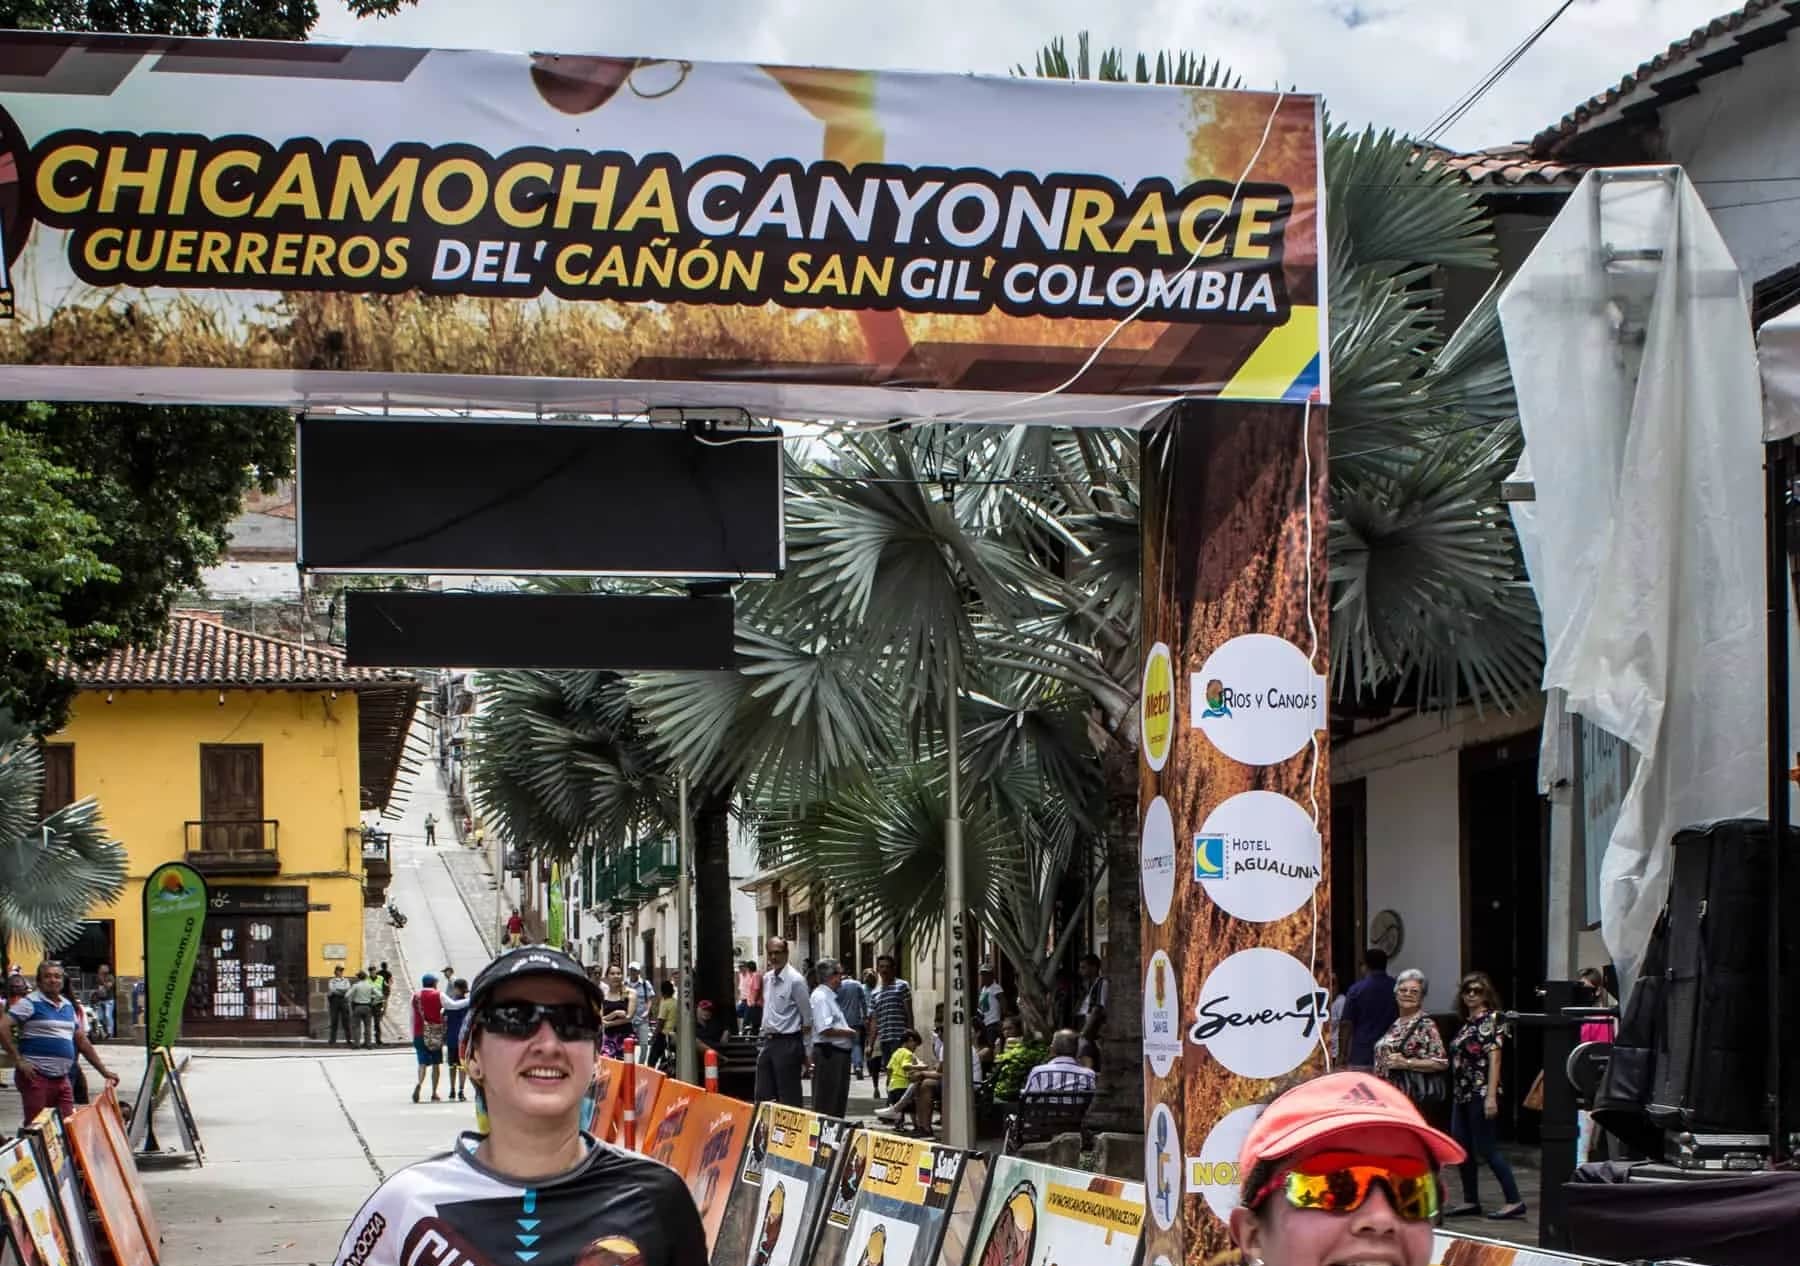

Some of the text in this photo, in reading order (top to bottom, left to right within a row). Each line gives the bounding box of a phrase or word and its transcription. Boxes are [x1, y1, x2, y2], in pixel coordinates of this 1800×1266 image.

[84, 230, 410, 279] GUERREROS
[555, 237, 764, 293] CAÑÓN
[1003, 262, 1277, 313] COLOMBIA
[1234, 857, 1320, 880] AGUALUNA
